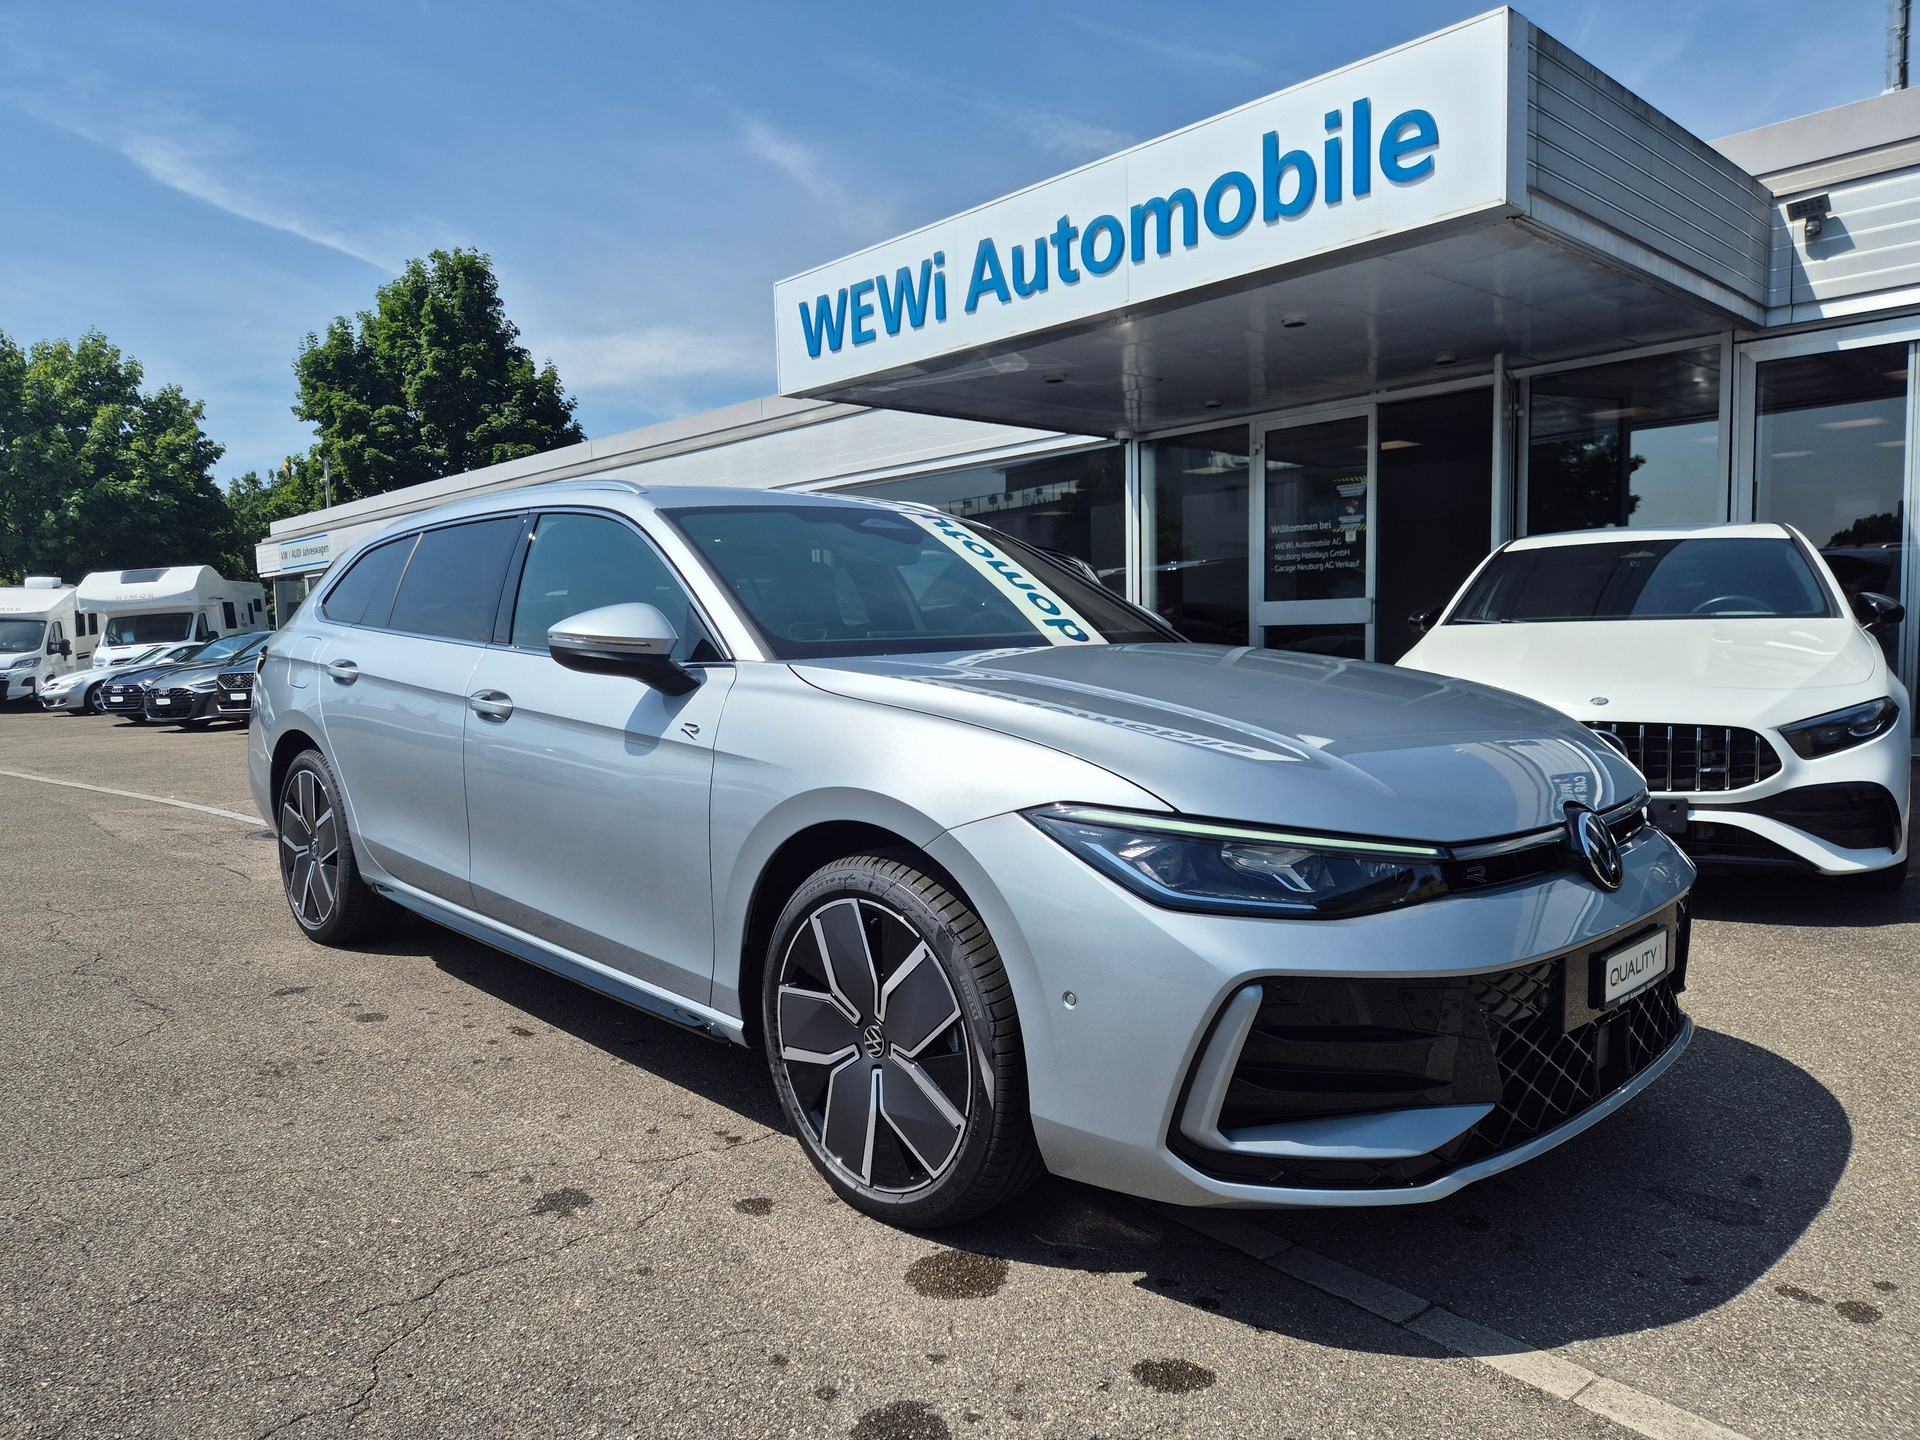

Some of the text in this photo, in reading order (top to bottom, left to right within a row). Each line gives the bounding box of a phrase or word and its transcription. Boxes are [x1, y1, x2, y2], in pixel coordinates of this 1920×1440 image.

[798, 97, 1440, 359] WEWi Automobile
[1271, 522, 1318, 534] Willkommen
[1319, 520, 1332, 530] bei
[1295, 539, 1331, 549] Automobile
[1332, 537, 1342, 546] AG
[280, 550, 288, 560] VW
[291, 547, 302, 559] AUDI
[302, 544, 330, 557] Jahreswagen
[1275, 548, 1351, 562] Neuburg Holidays GmbH
[1275, 559, 1361, 574] Garage Neuburg AG Verkauf
[959, 972, 983, 1021] PIRELLI
